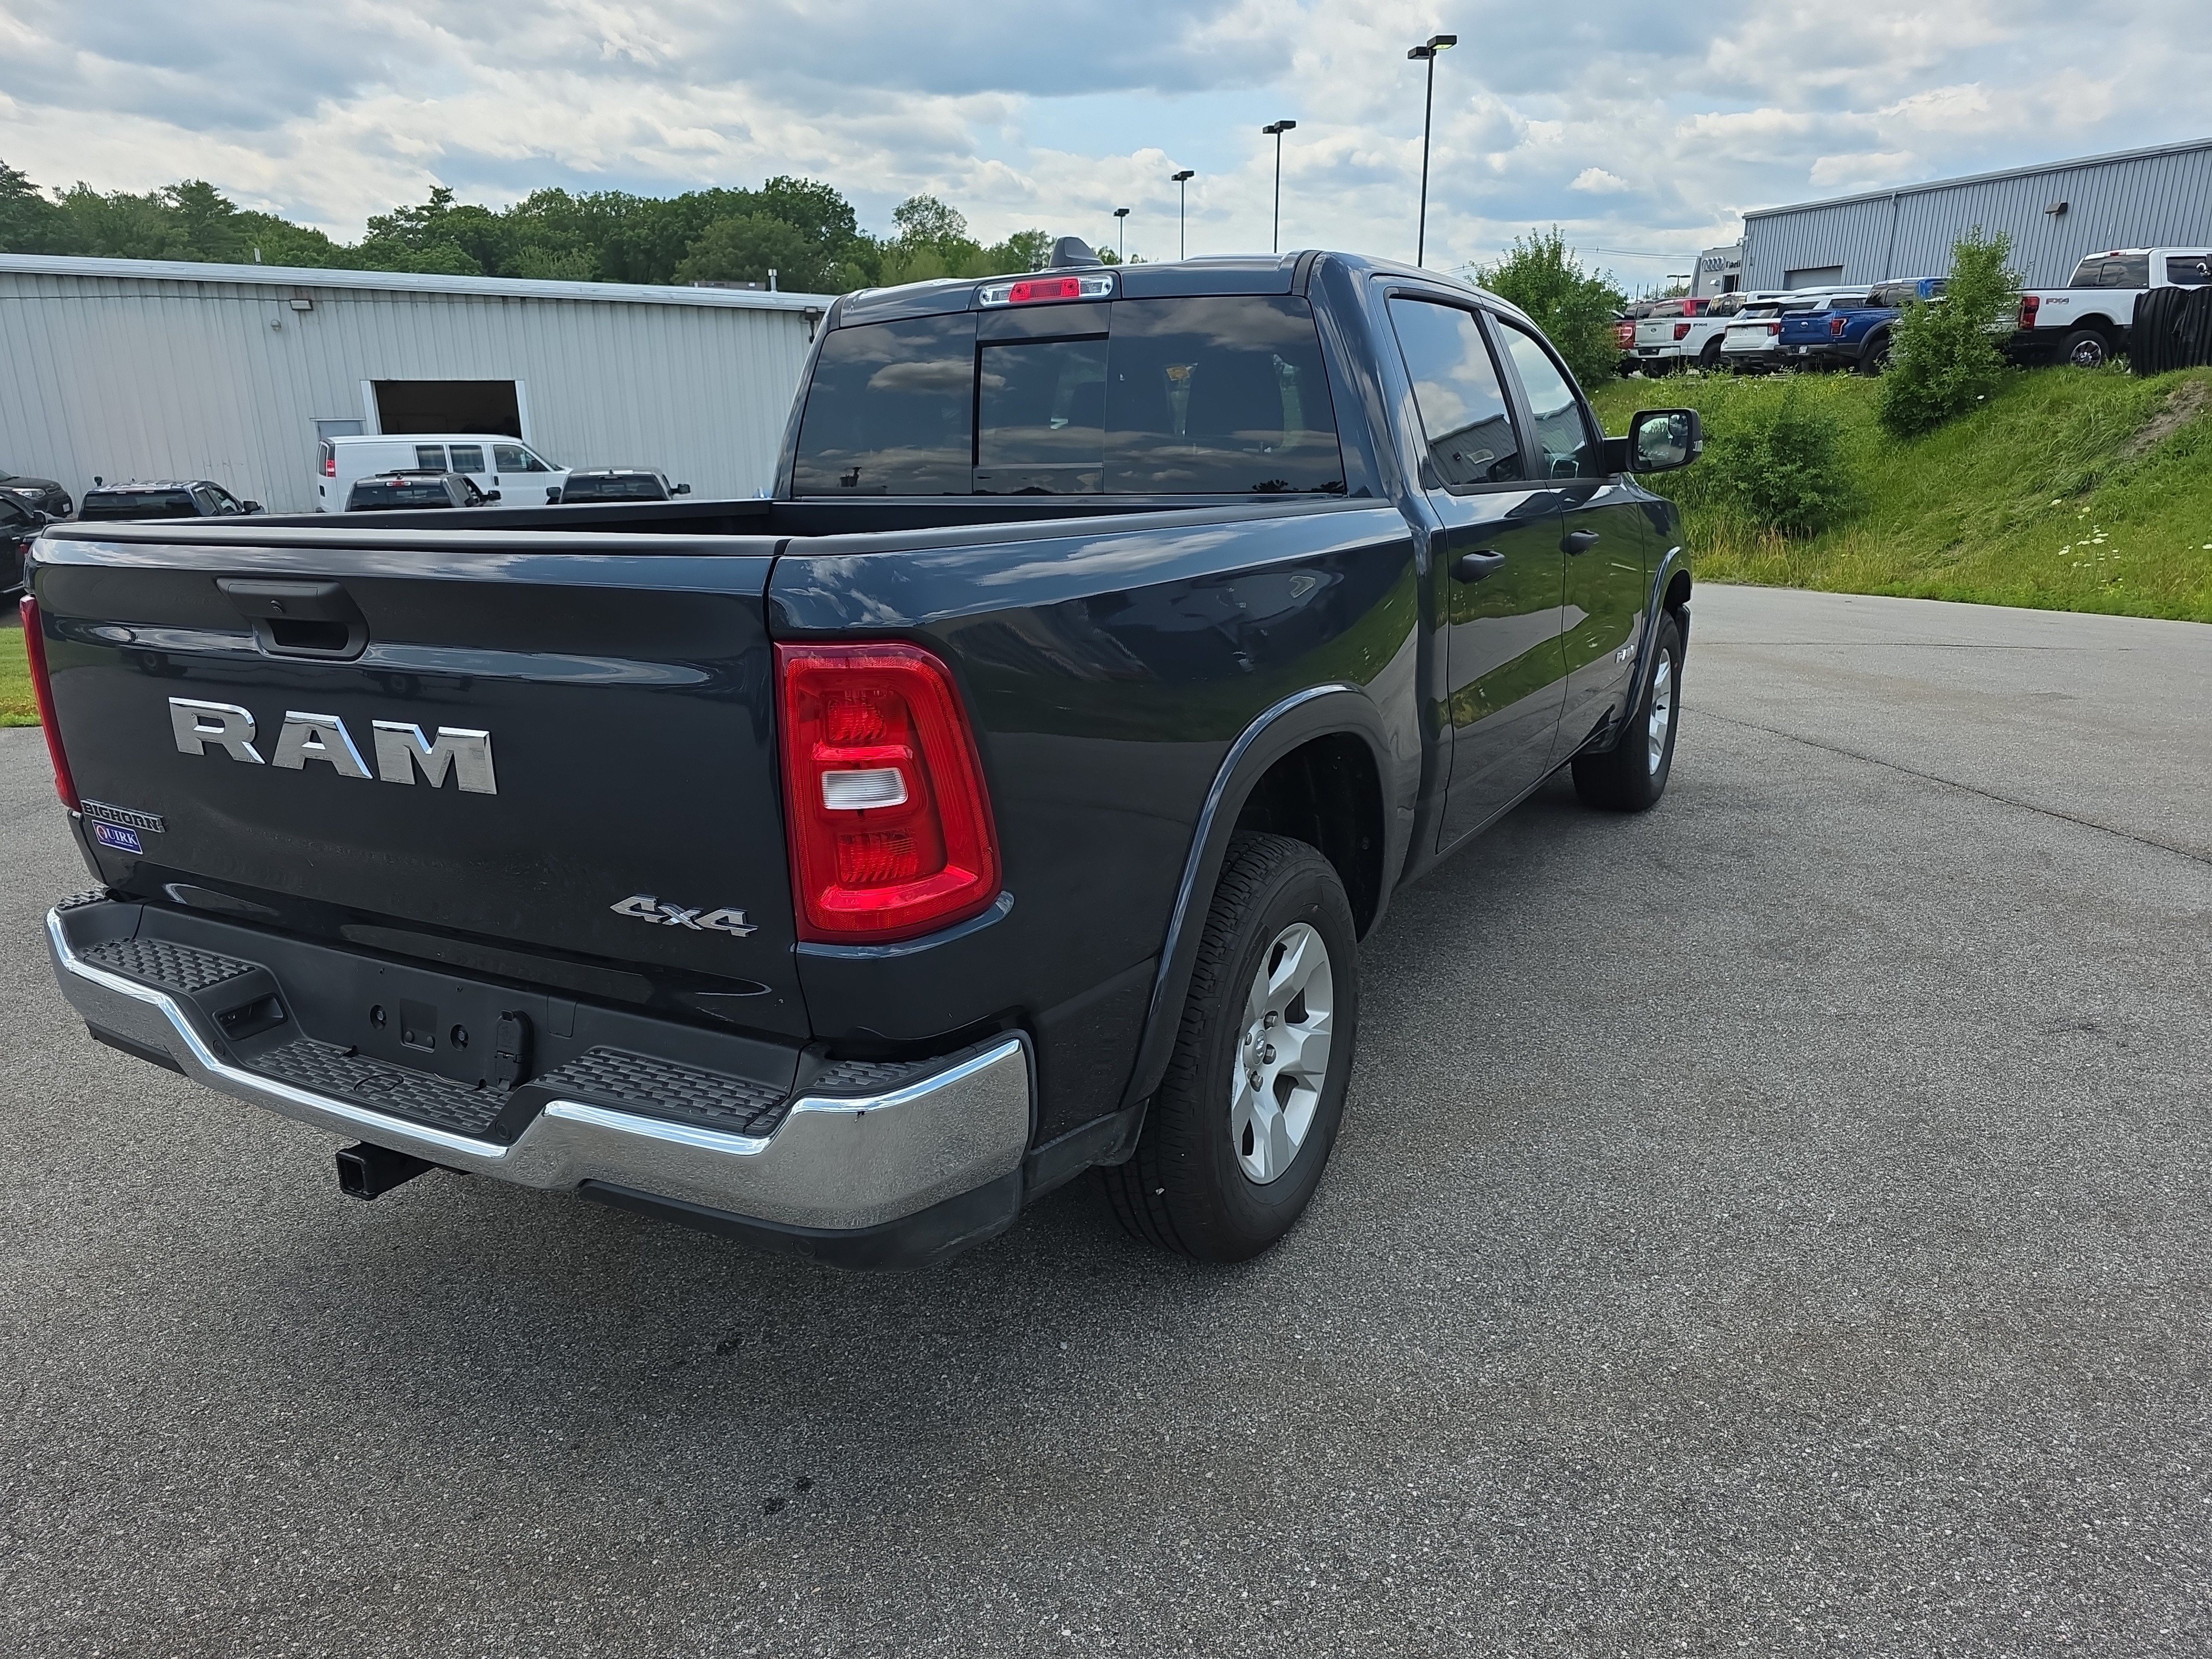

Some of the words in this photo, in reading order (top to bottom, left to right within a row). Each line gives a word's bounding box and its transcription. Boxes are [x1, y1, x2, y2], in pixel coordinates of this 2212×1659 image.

[169, 697, 498, 795] RAM
[81, 801, 163, 832] BIGHORN
[96, 825, 138, 845] QUIRK
